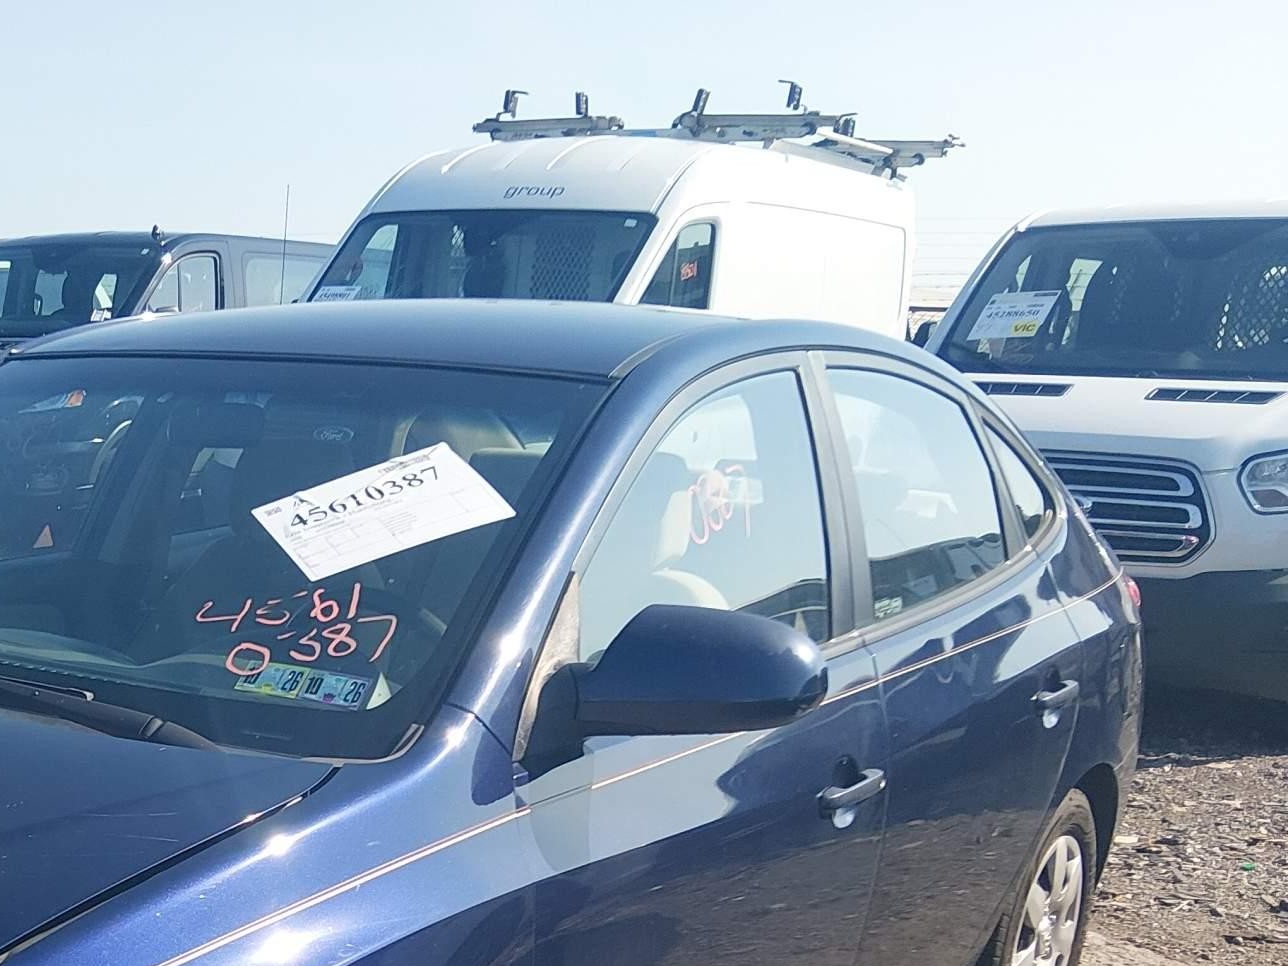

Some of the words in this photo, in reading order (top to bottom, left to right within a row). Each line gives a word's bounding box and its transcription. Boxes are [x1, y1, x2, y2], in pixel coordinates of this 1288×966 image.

[503, 186, 565, 199] group
[1014, 323, 1037, 332] VIC
[290, 465, 439, 529] 45610387
[280, 670, 305, 692] 26
[304, 676, 325, 695] 10
[343, 680, 366, 704] 26
